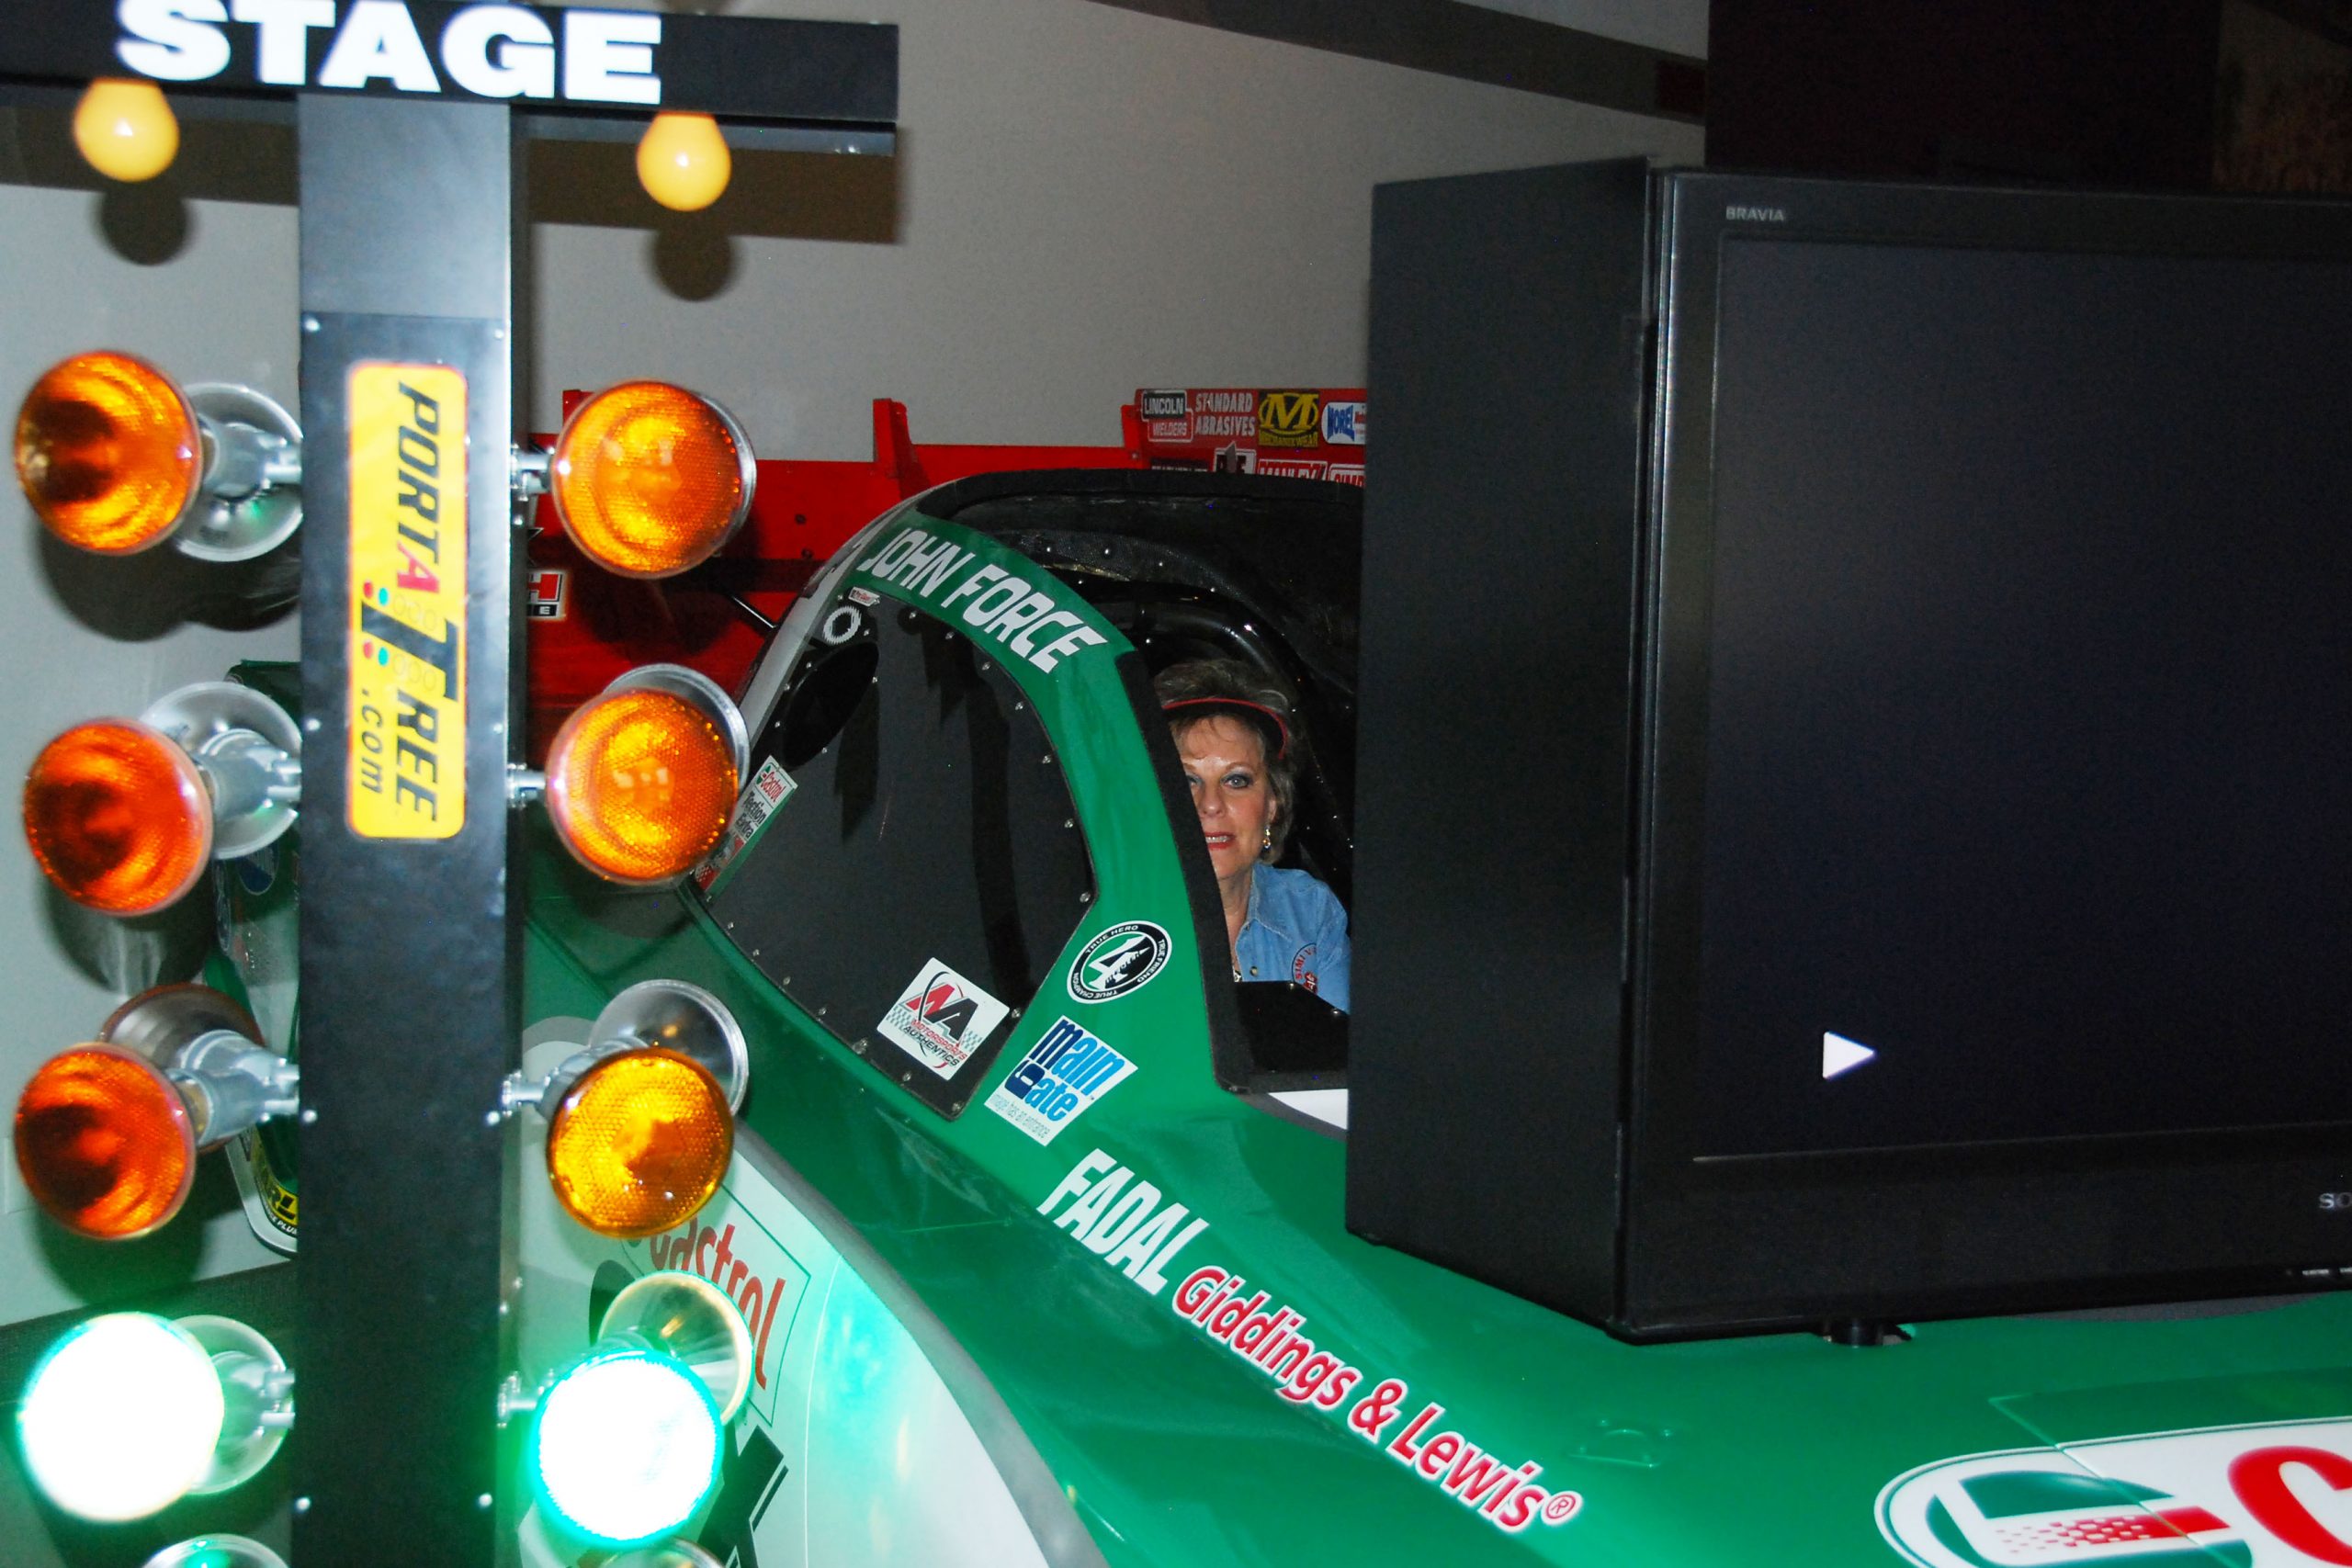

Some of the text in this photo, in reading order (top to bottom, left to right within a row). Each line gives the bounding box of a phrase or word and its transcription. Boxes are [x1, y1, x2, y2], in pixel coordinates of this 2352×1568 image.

[117, 0, 662, 105] STAGE
[1726, 205, 1784, 221] BRAVIA
[1144, 397, 1185, 415] LINCOLN
[1195, 392, 1254, 413] STANDARD
[1153, 423, 1188, 436] WELDERS
[1195, 416, 1256, 437] ABRASIVES
[856, 527, 1109, 674] JOHN FORCE
[761, 771, 786, 803] Castrol
[1085, 924, 1139, 954] TRUE HERO
[903, 1026, 960, 1066] AUTHENTICS
[910, 1019, 968, 1061] MOTORSPORTS
[1028, 1019, 1125, 1097] main
[1036, 1148, 1209, 1295] FADAL
[1172, 1265, 1363, 1410] Giddings
[1348, 1379, 1408, 1445] &
